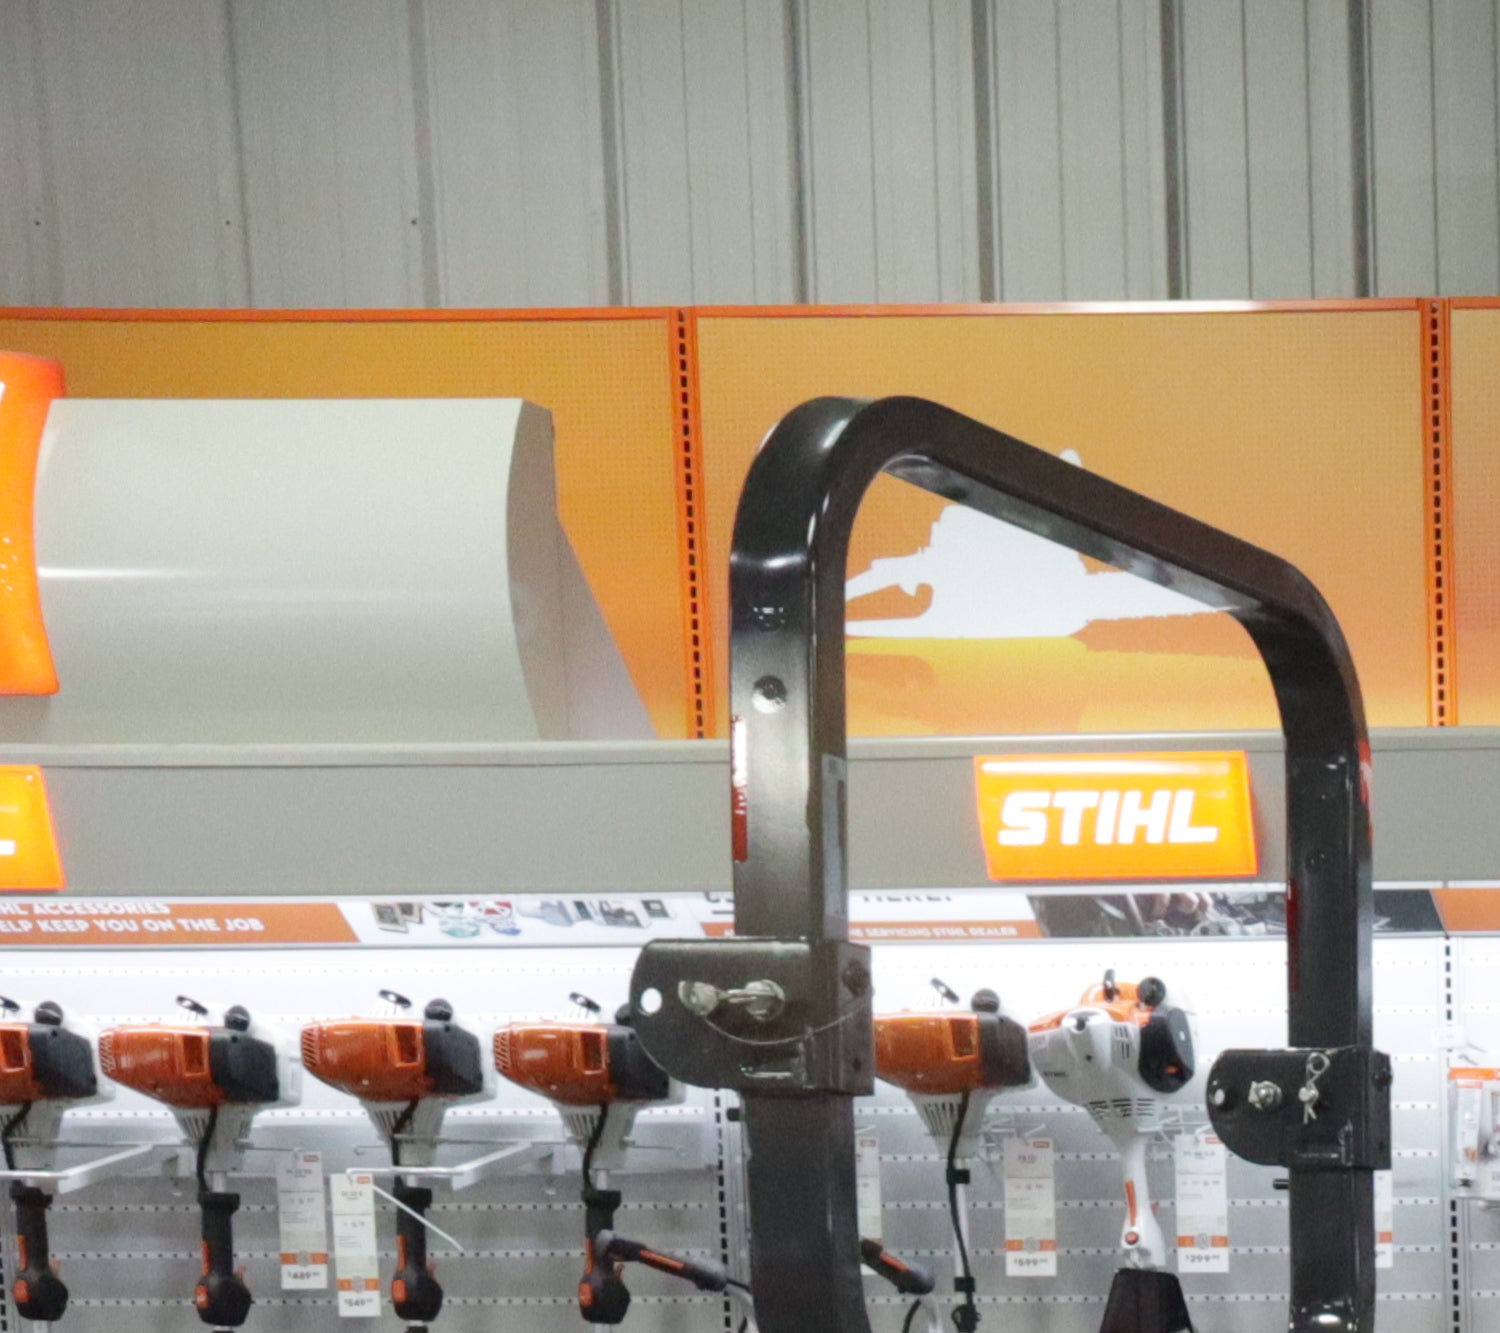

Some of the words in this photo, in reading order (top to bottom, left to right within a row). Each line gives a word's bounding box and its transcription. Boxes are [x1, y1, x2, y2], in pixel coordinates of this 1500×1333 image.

[998, 789, 1219, 845] STIHL
[33, 902, 172, 916] ACCESSORIES
[38, 918, 90, 933] KEEP
[98, 918, 139, 932] YOU
[149, 918, 175, 932] ON
[181, 917, 220, 932] THE
[225, 917, 265, 932] JOB
